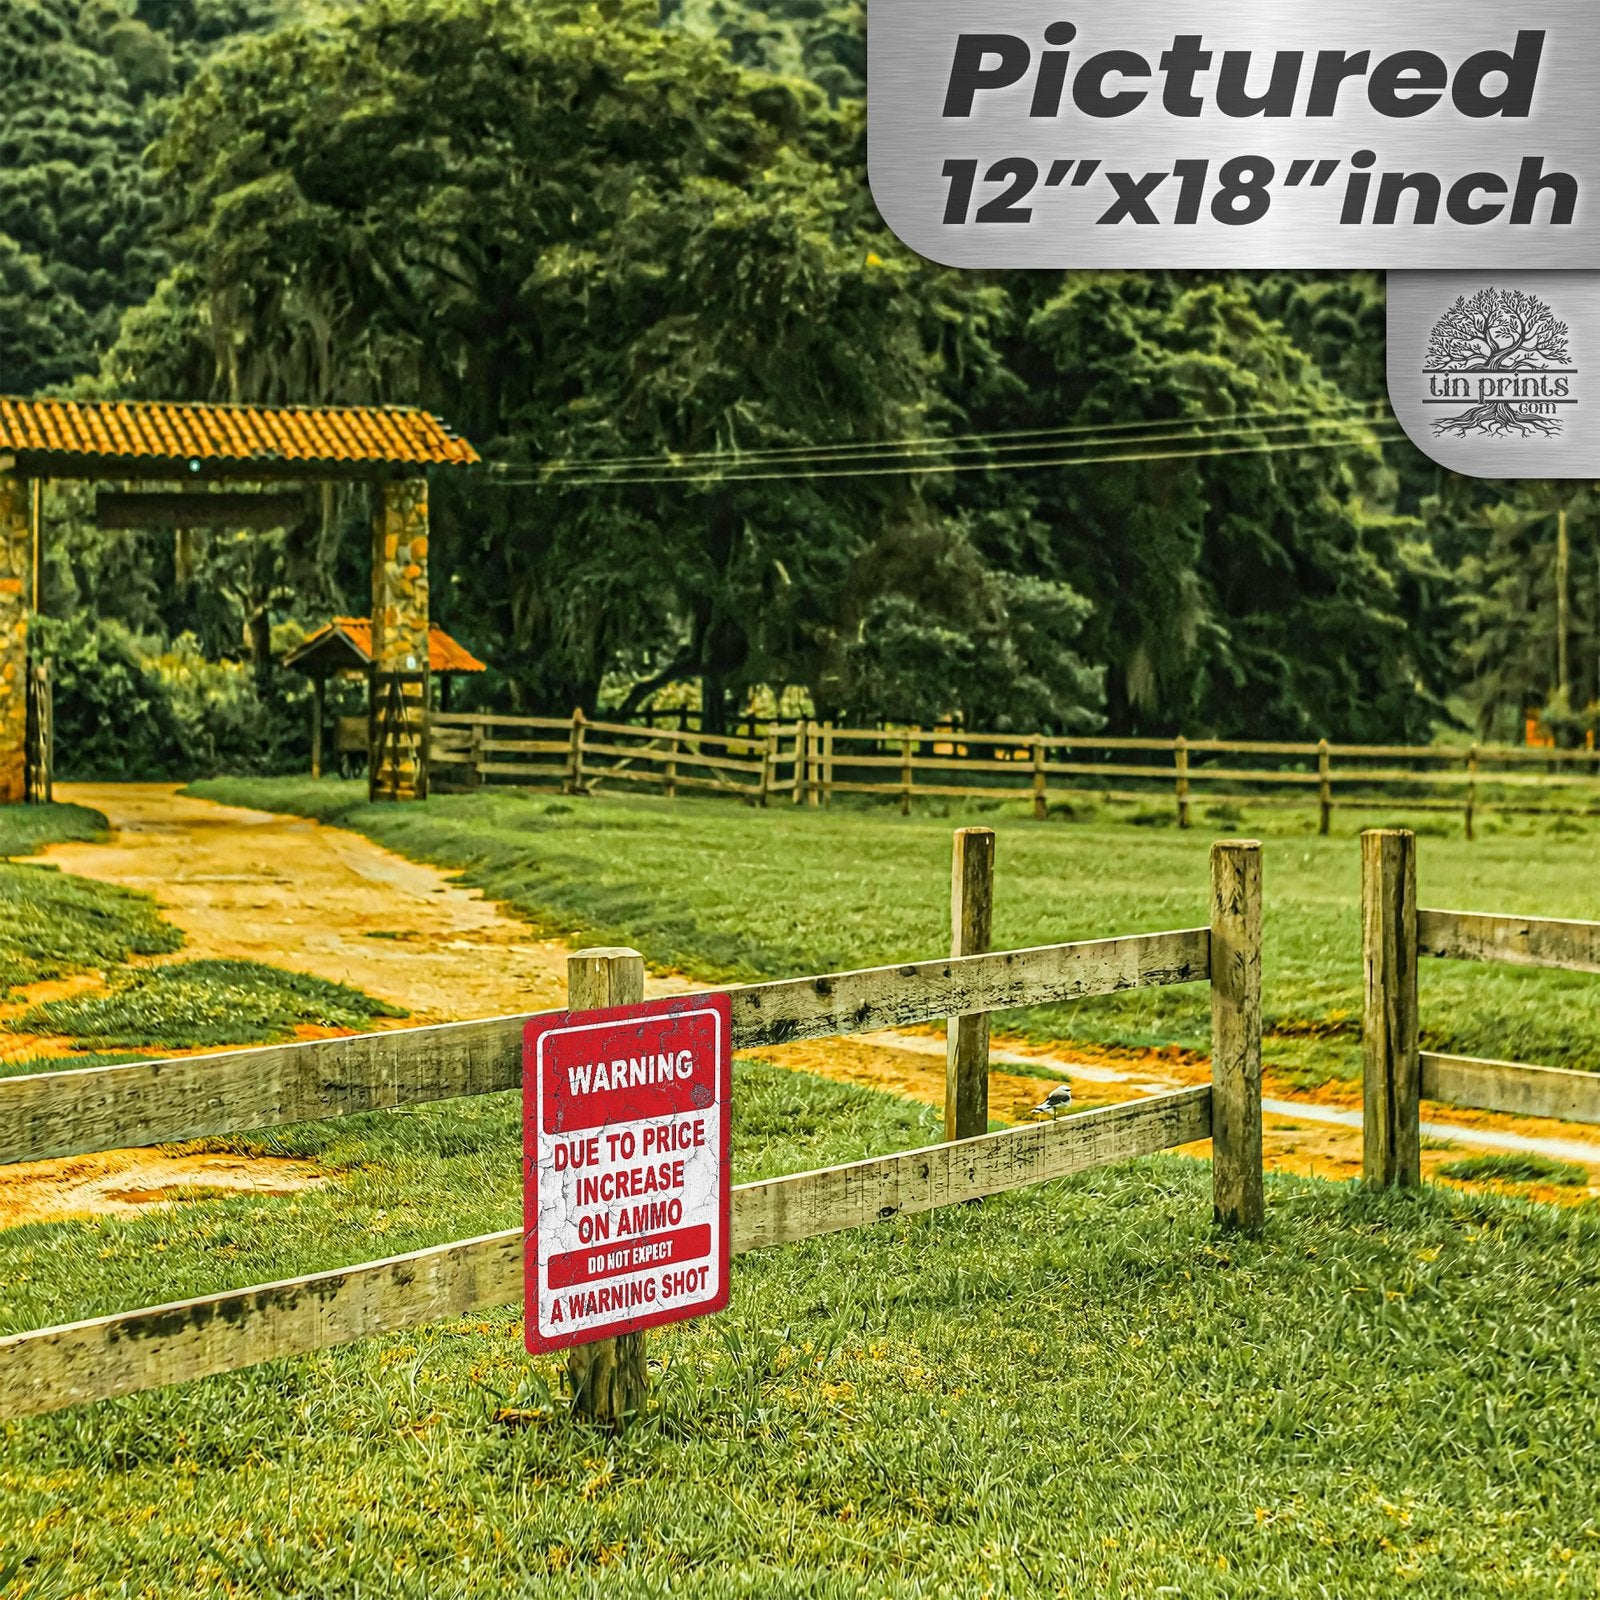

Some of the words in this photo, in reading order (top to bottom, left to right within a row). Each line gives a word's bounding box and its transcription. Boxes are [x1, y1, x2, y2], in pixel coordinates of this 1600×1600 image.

[568, 1049, 693, 1096] WARNING
[554, 1141, 599, 1172] DUE
[606, 1131, 636, 1162] TO
[643, 1119, 705, 1154] PRICE
[576, 1159, 685, 1206] INCREASE
[578, 1215, 610, 1244] ON
[617, 1198, 683, 1236] AMMO
[587, 1255, 604, 1275] DO
[607, 1249, 630, 1270] NOT
[632, 1240, 673, 1266] EXPECT
[550, 1299, 564, 1325] A
[568, 1278, 656, 1321] WARNING
[661, 1265, 709, 1299] SHOT
